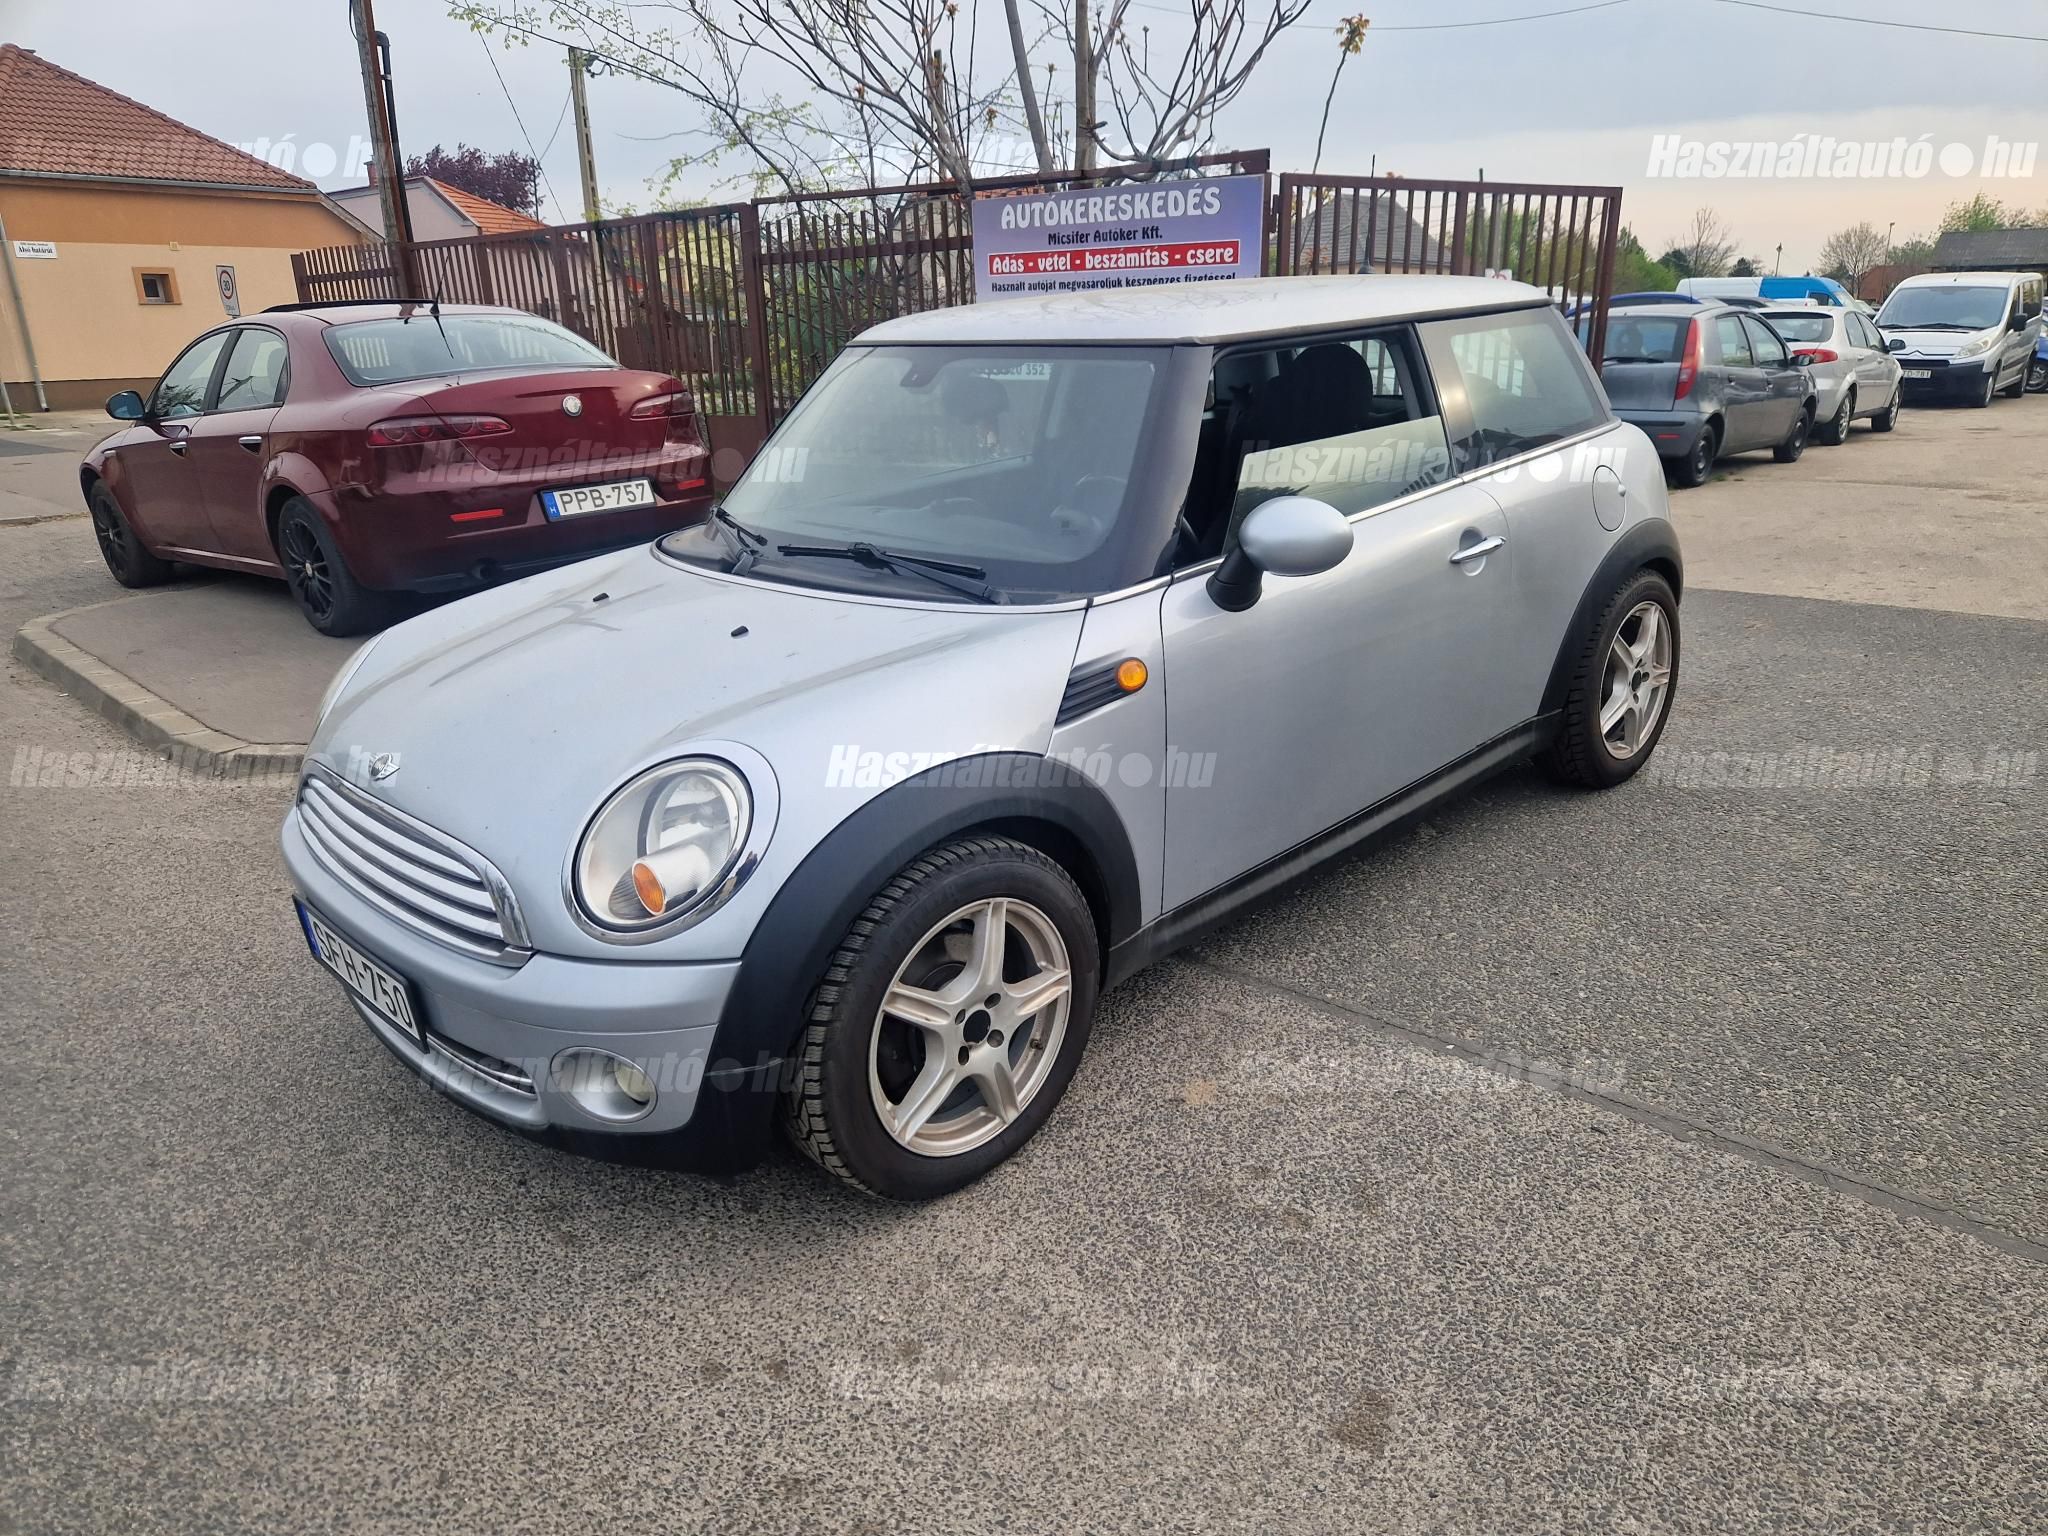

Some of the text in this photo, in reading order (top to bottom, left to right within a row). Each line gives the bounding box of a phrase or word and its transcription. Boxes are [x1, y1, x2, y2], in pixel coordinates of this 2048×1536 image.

[1001, 184, 1221, 230] AUTÓKERESKEDÉS
[1048, 230, 1091, 246] Micsifer
[1141, 226, 1163, 241] Kft.
[993, 255, 1024, 273] Adás
[1037, 253, 1071, 272] vétel
[1085, 246, 1169, 269] beszámítás
[1186, 246, 1234, 265] csere
[223, 280, 231, 291] 30
[1025, 364, 1045, 376] 352
[558, 482, 645, 512] PPB-757
[312, 920, 413, 1029] SFH-750
